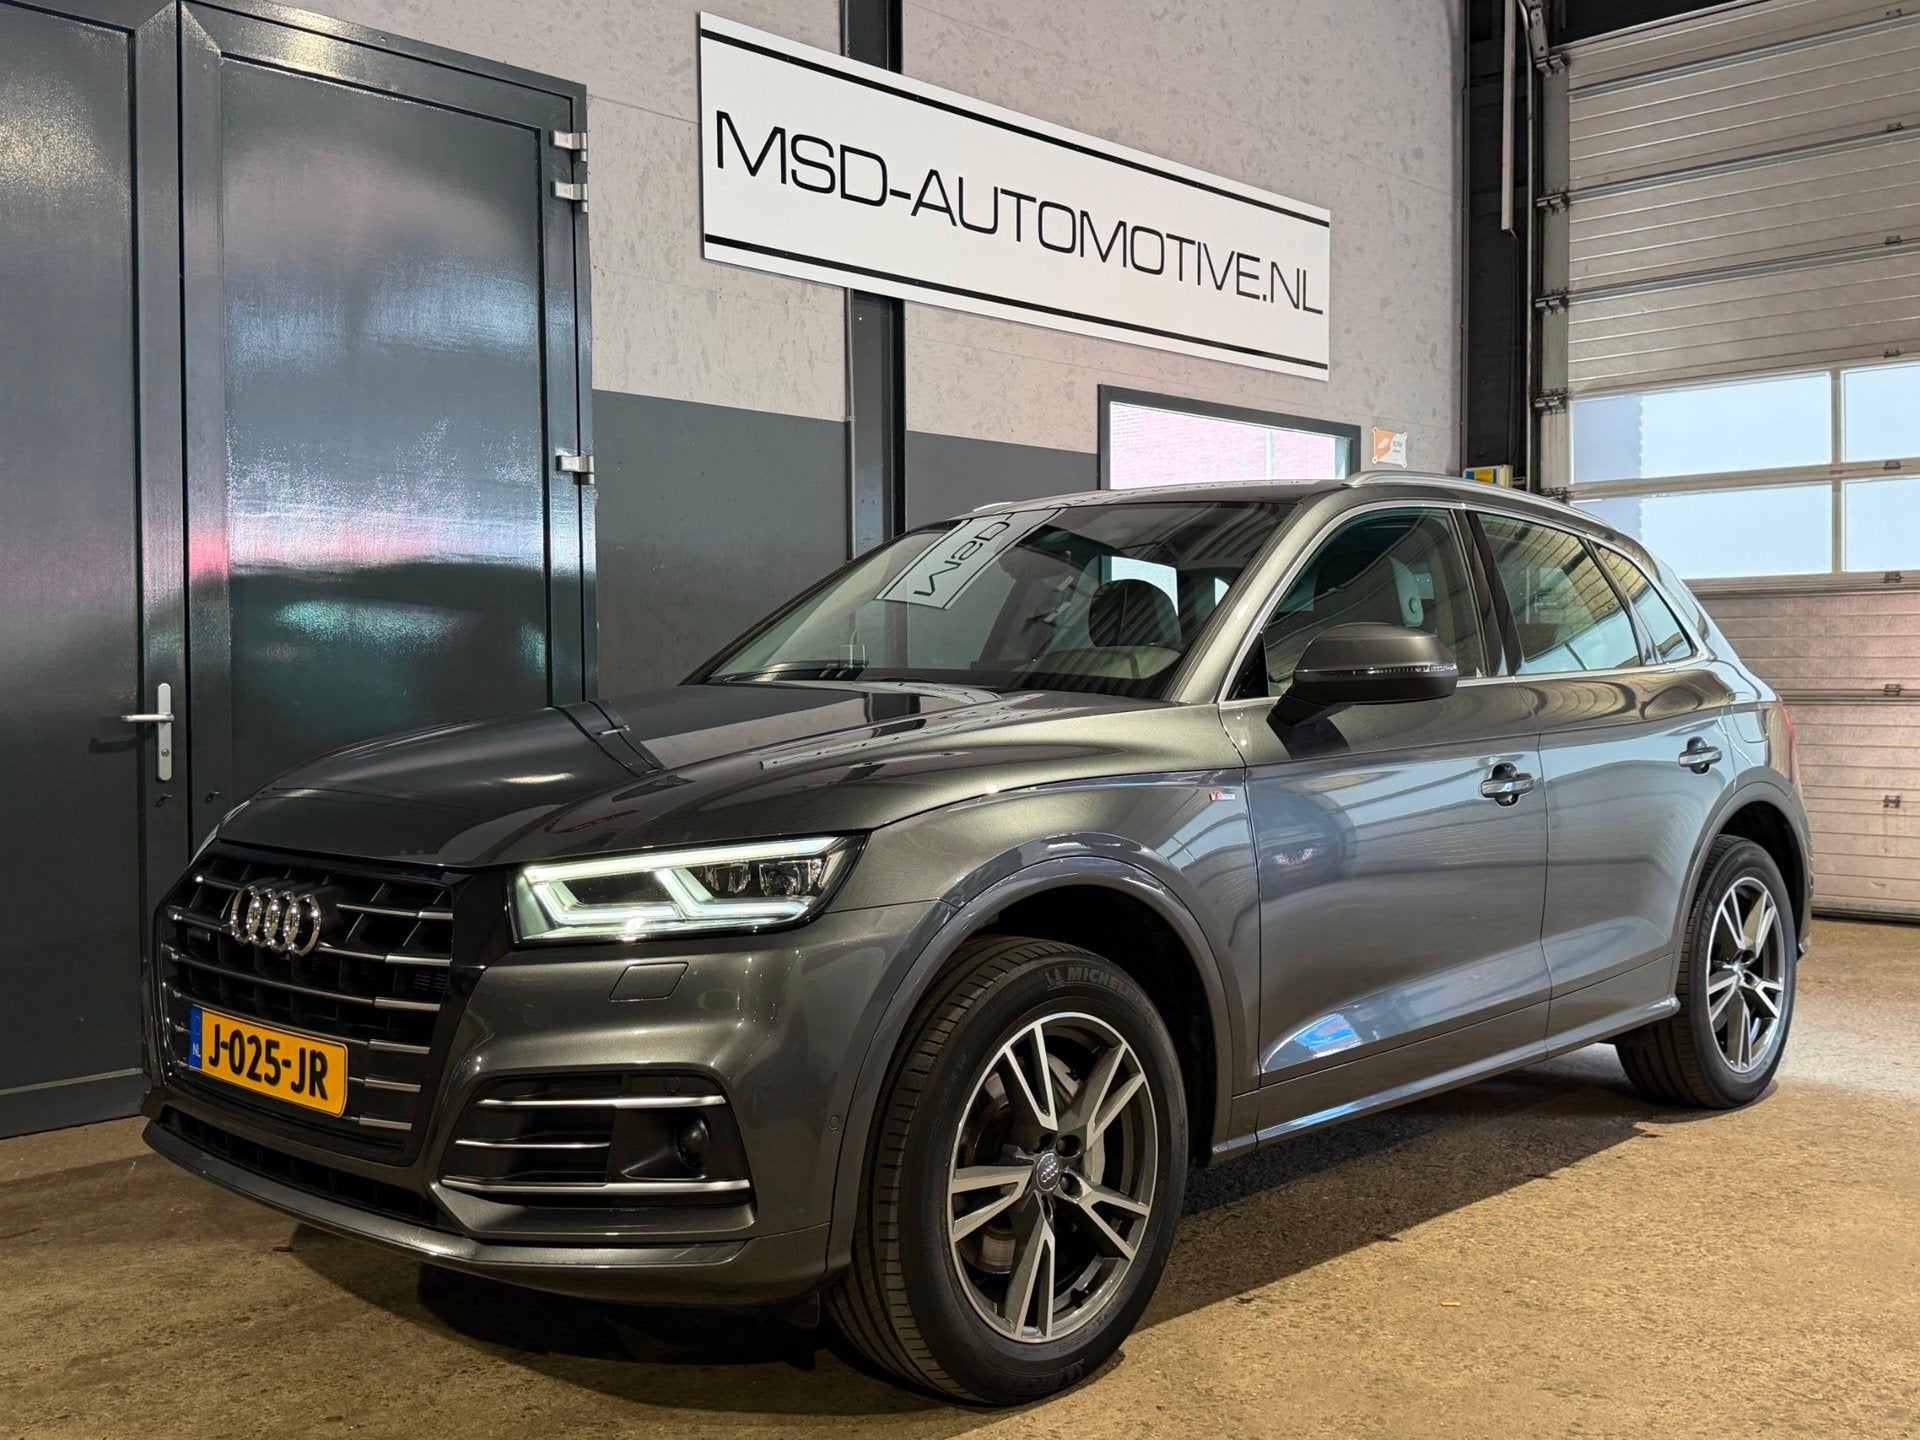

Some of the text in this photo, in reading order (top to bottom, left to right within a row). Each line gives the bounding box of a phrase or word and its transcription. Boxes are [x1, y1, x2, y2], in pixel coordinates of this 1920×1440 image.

[716, 110, 1323, 315] MSD-AUTOMOTIVE.NL
[192, 1042, 202, 1058] NL
[208, 1023, 328, 1101] J-025-JR
